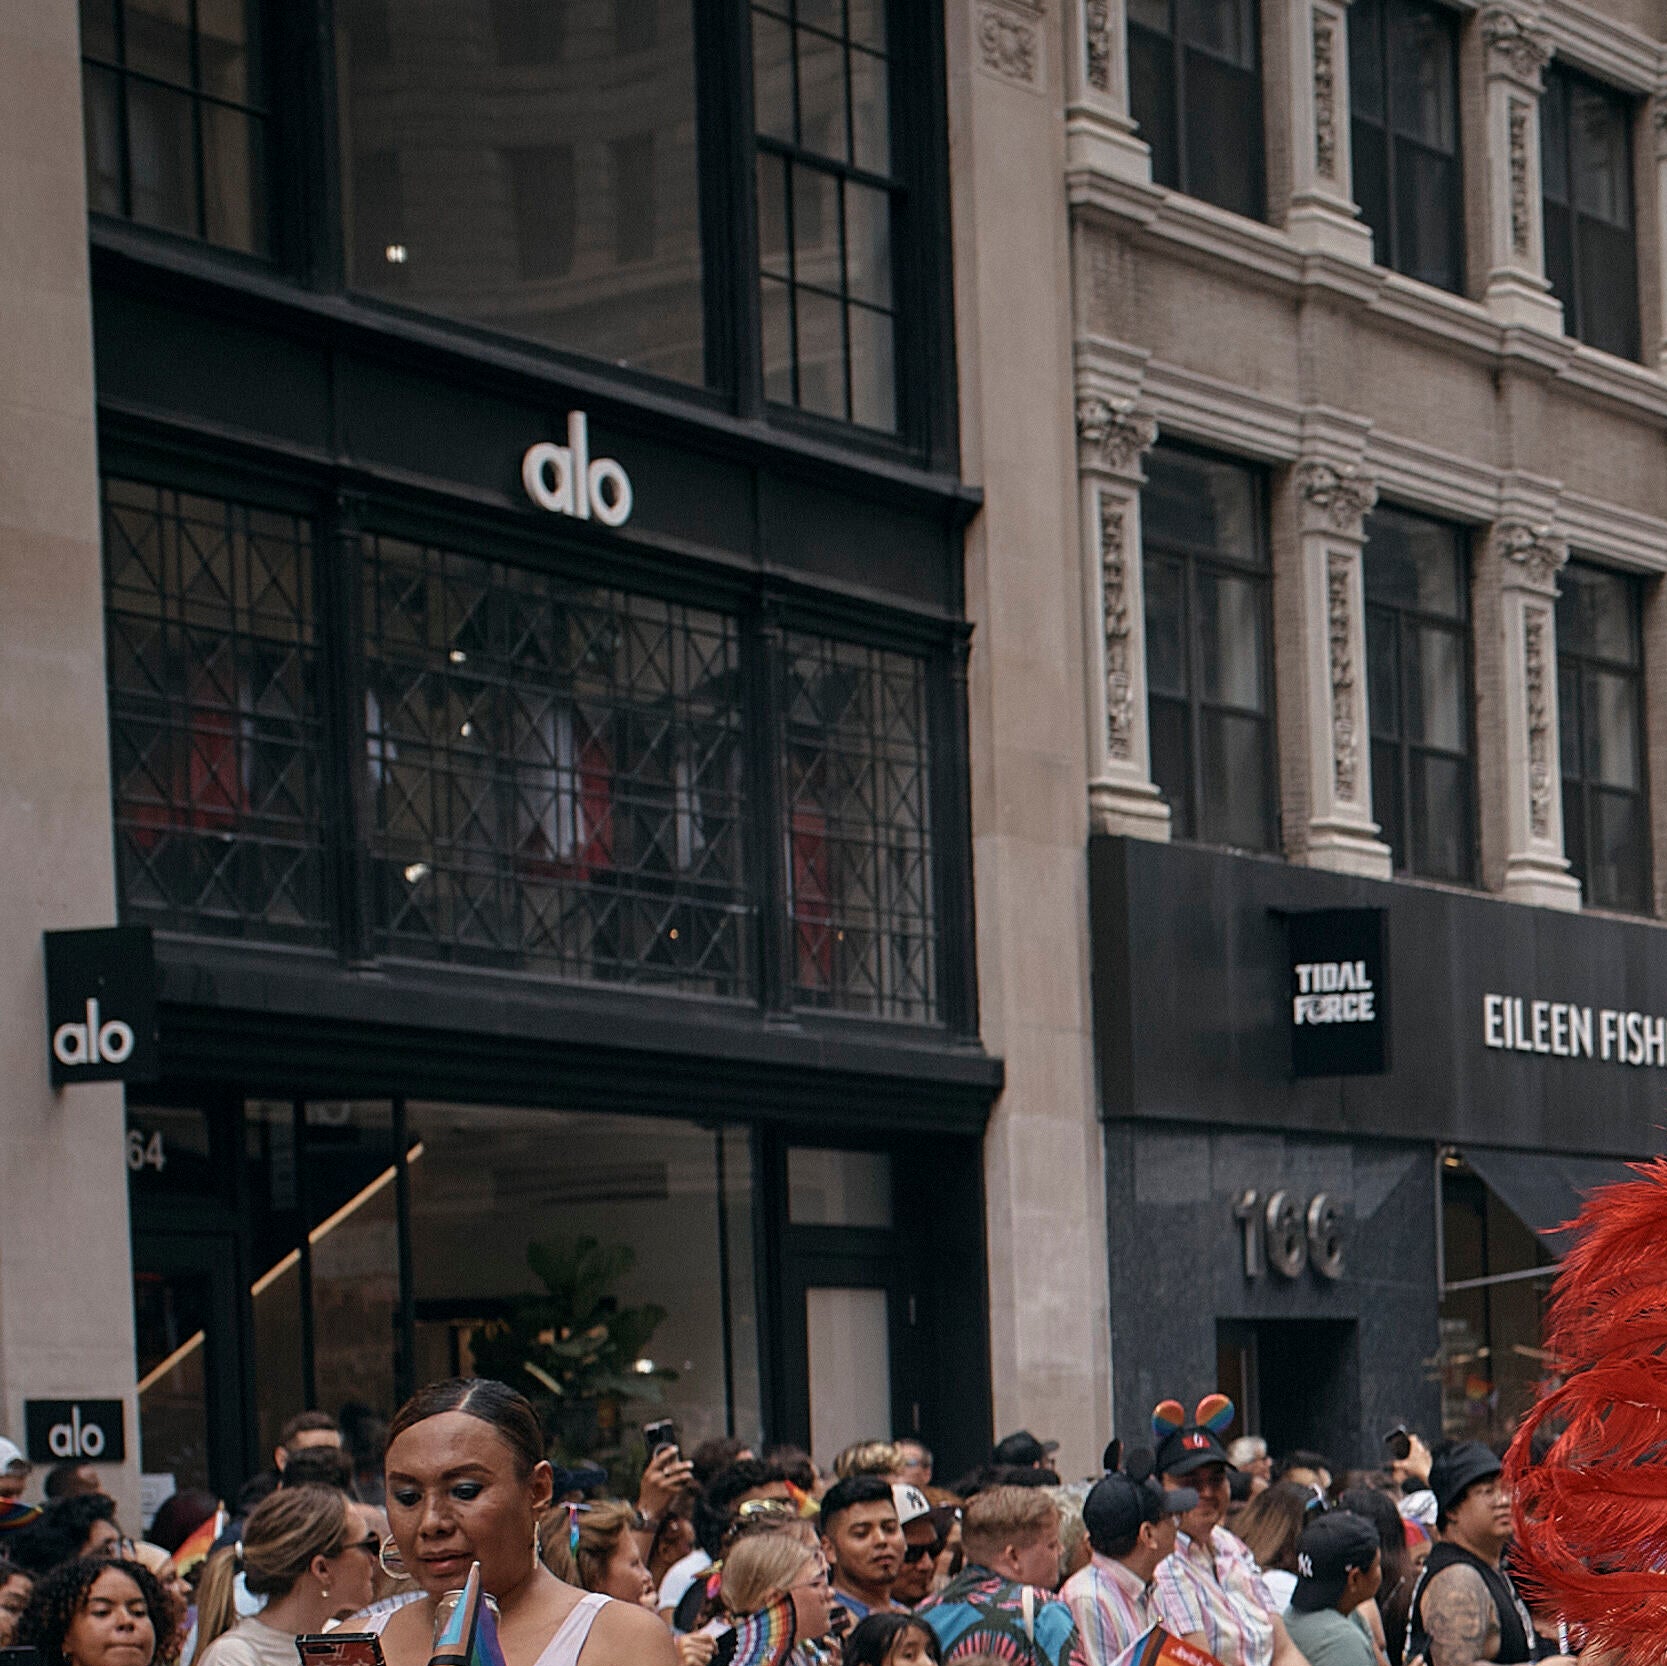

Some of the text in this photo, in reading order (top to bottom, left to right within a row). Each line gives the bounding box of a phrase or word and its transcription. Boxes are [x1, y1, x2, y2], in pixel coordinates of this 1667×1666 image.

[522, 409, 632, 526] alo
[1293, 991, 1376, 1025] FORCE
[1294, 960, 1373, 993] TIDAL
[53, 997, 135, 1066] alo
[1484, 993, 1594, 1059] EILEEN
[1233, 1189, 1345, 1279] 166
[48, 1404, 104, 1457] alo
